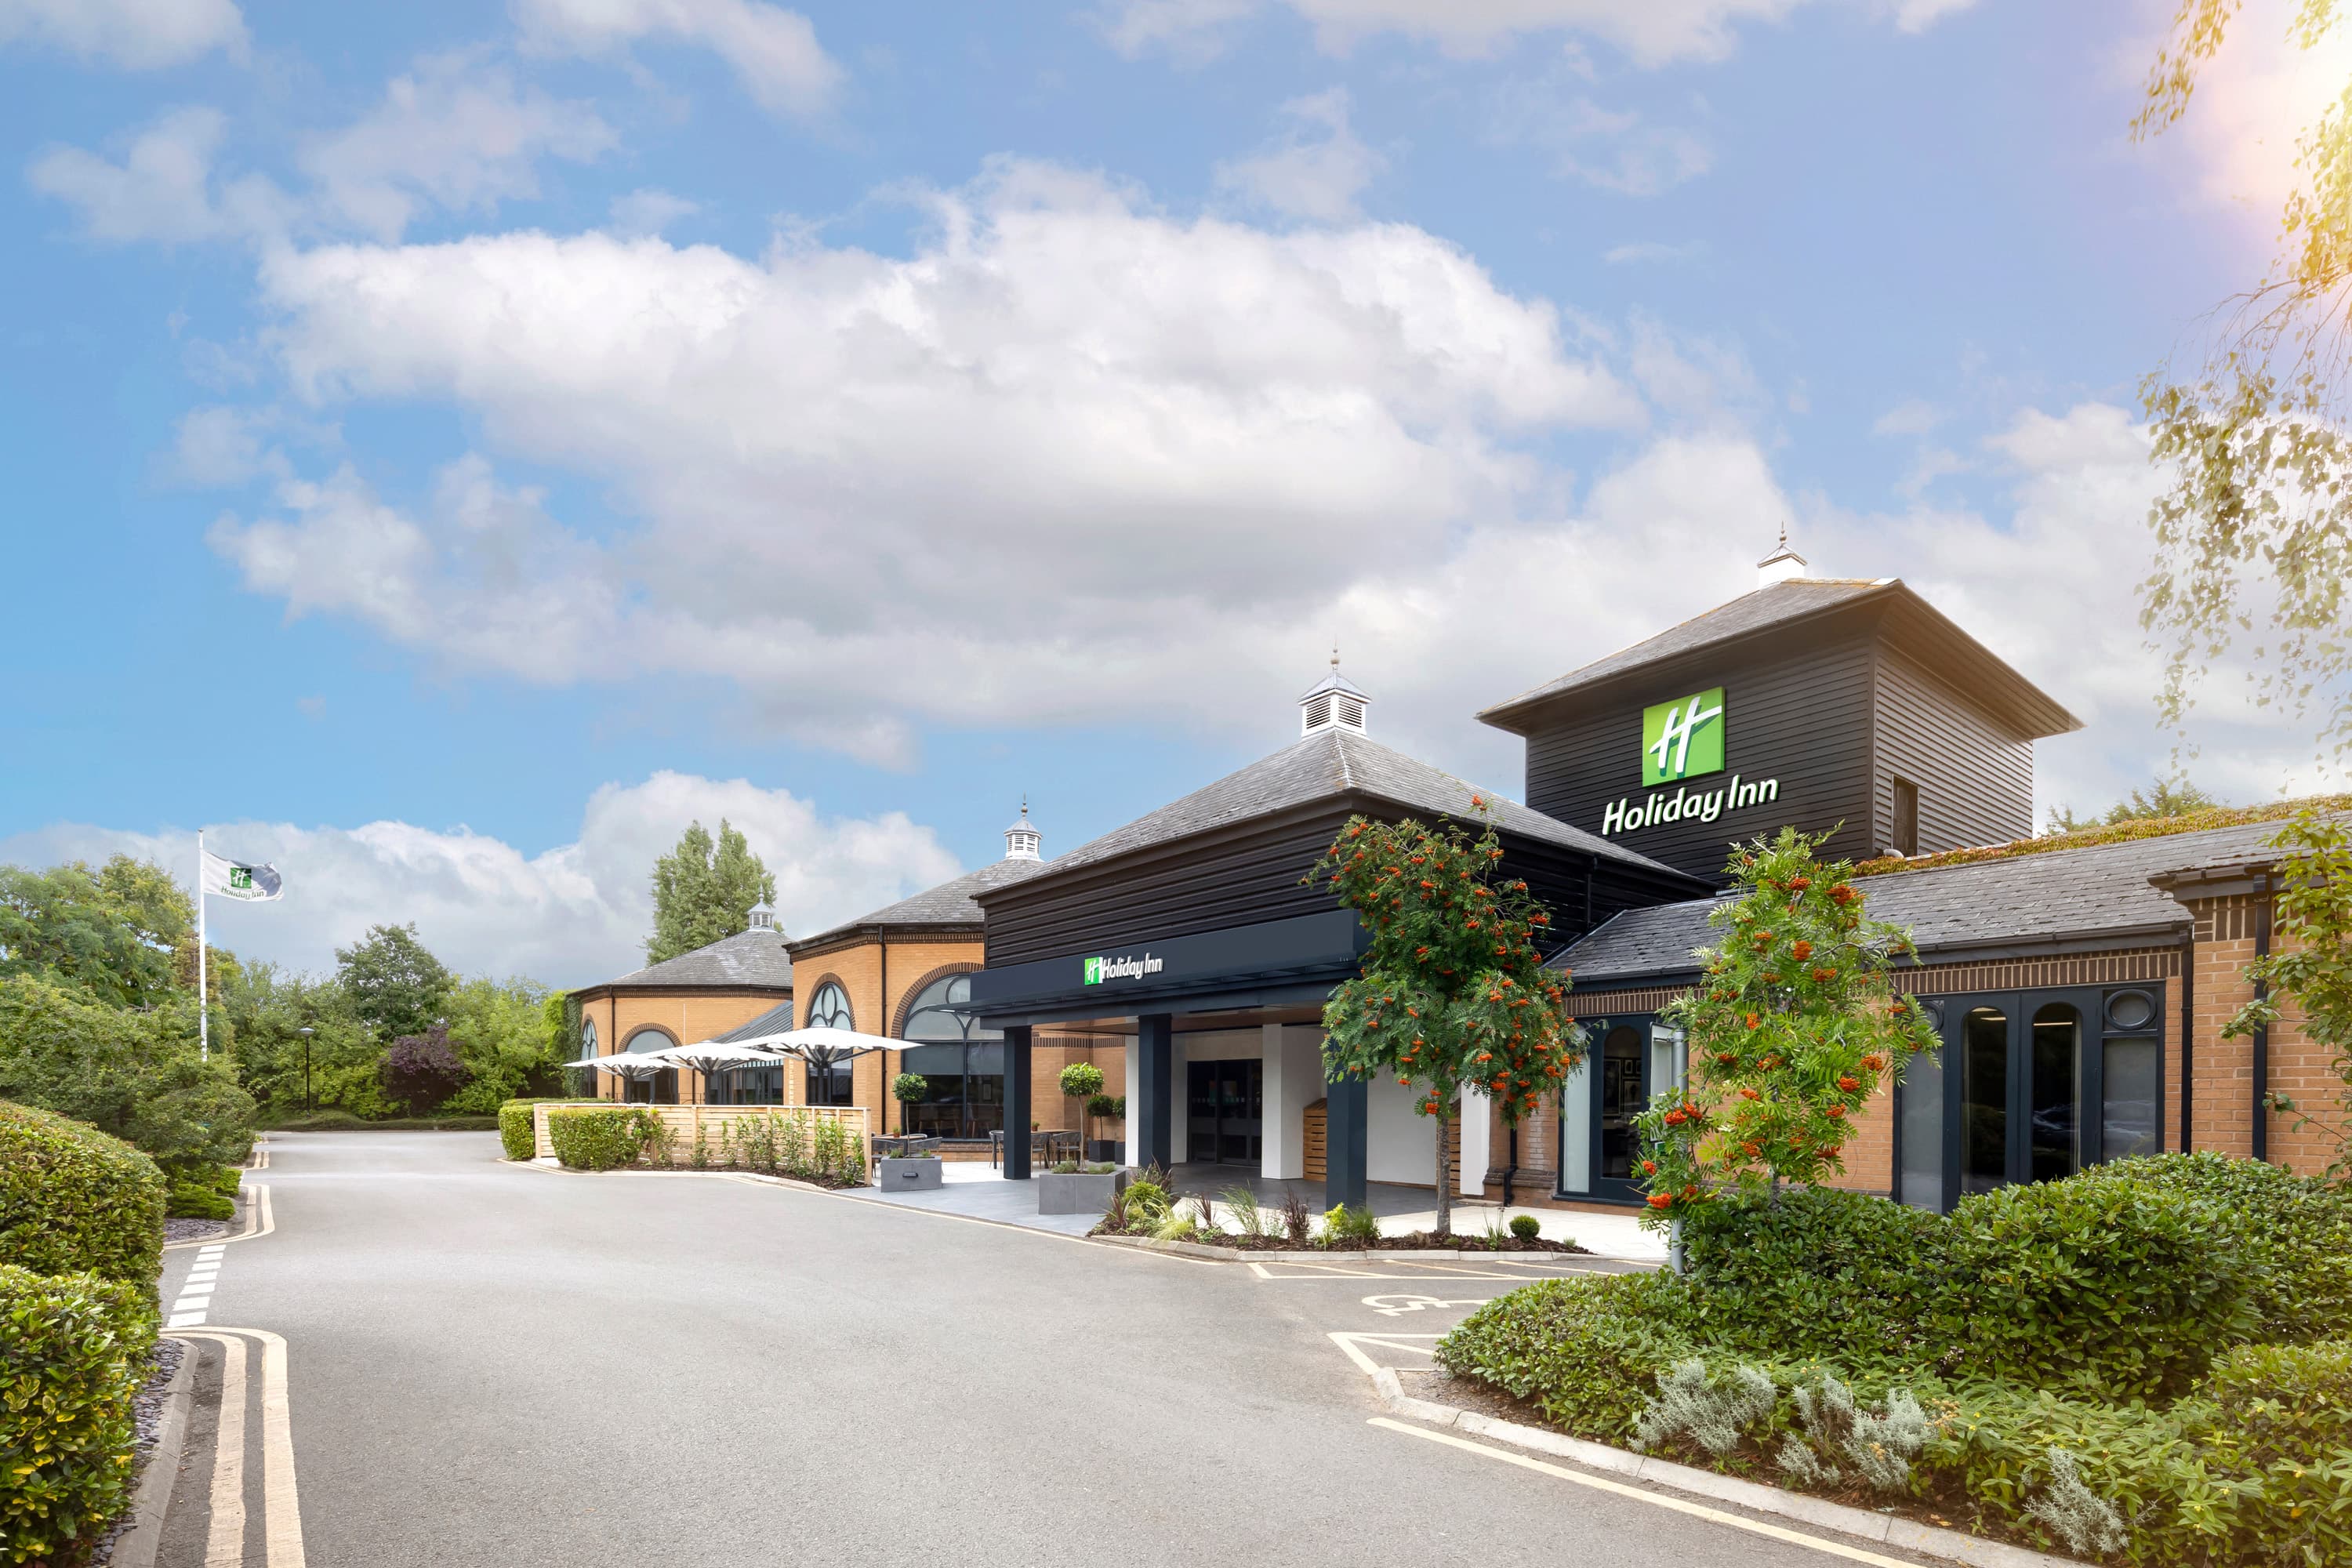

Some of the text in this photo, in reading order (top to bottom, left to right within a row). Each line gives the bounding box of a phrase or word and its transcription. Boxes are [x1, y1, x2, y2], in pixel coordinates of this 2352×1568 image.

[1602, 775, 1779, 835] Holiday Inn
[220, 886, 264, 899] Holiday Inn
[1102, 956, 1145, 979] Holiday
[1145, 953, 1163, 973] Inn
